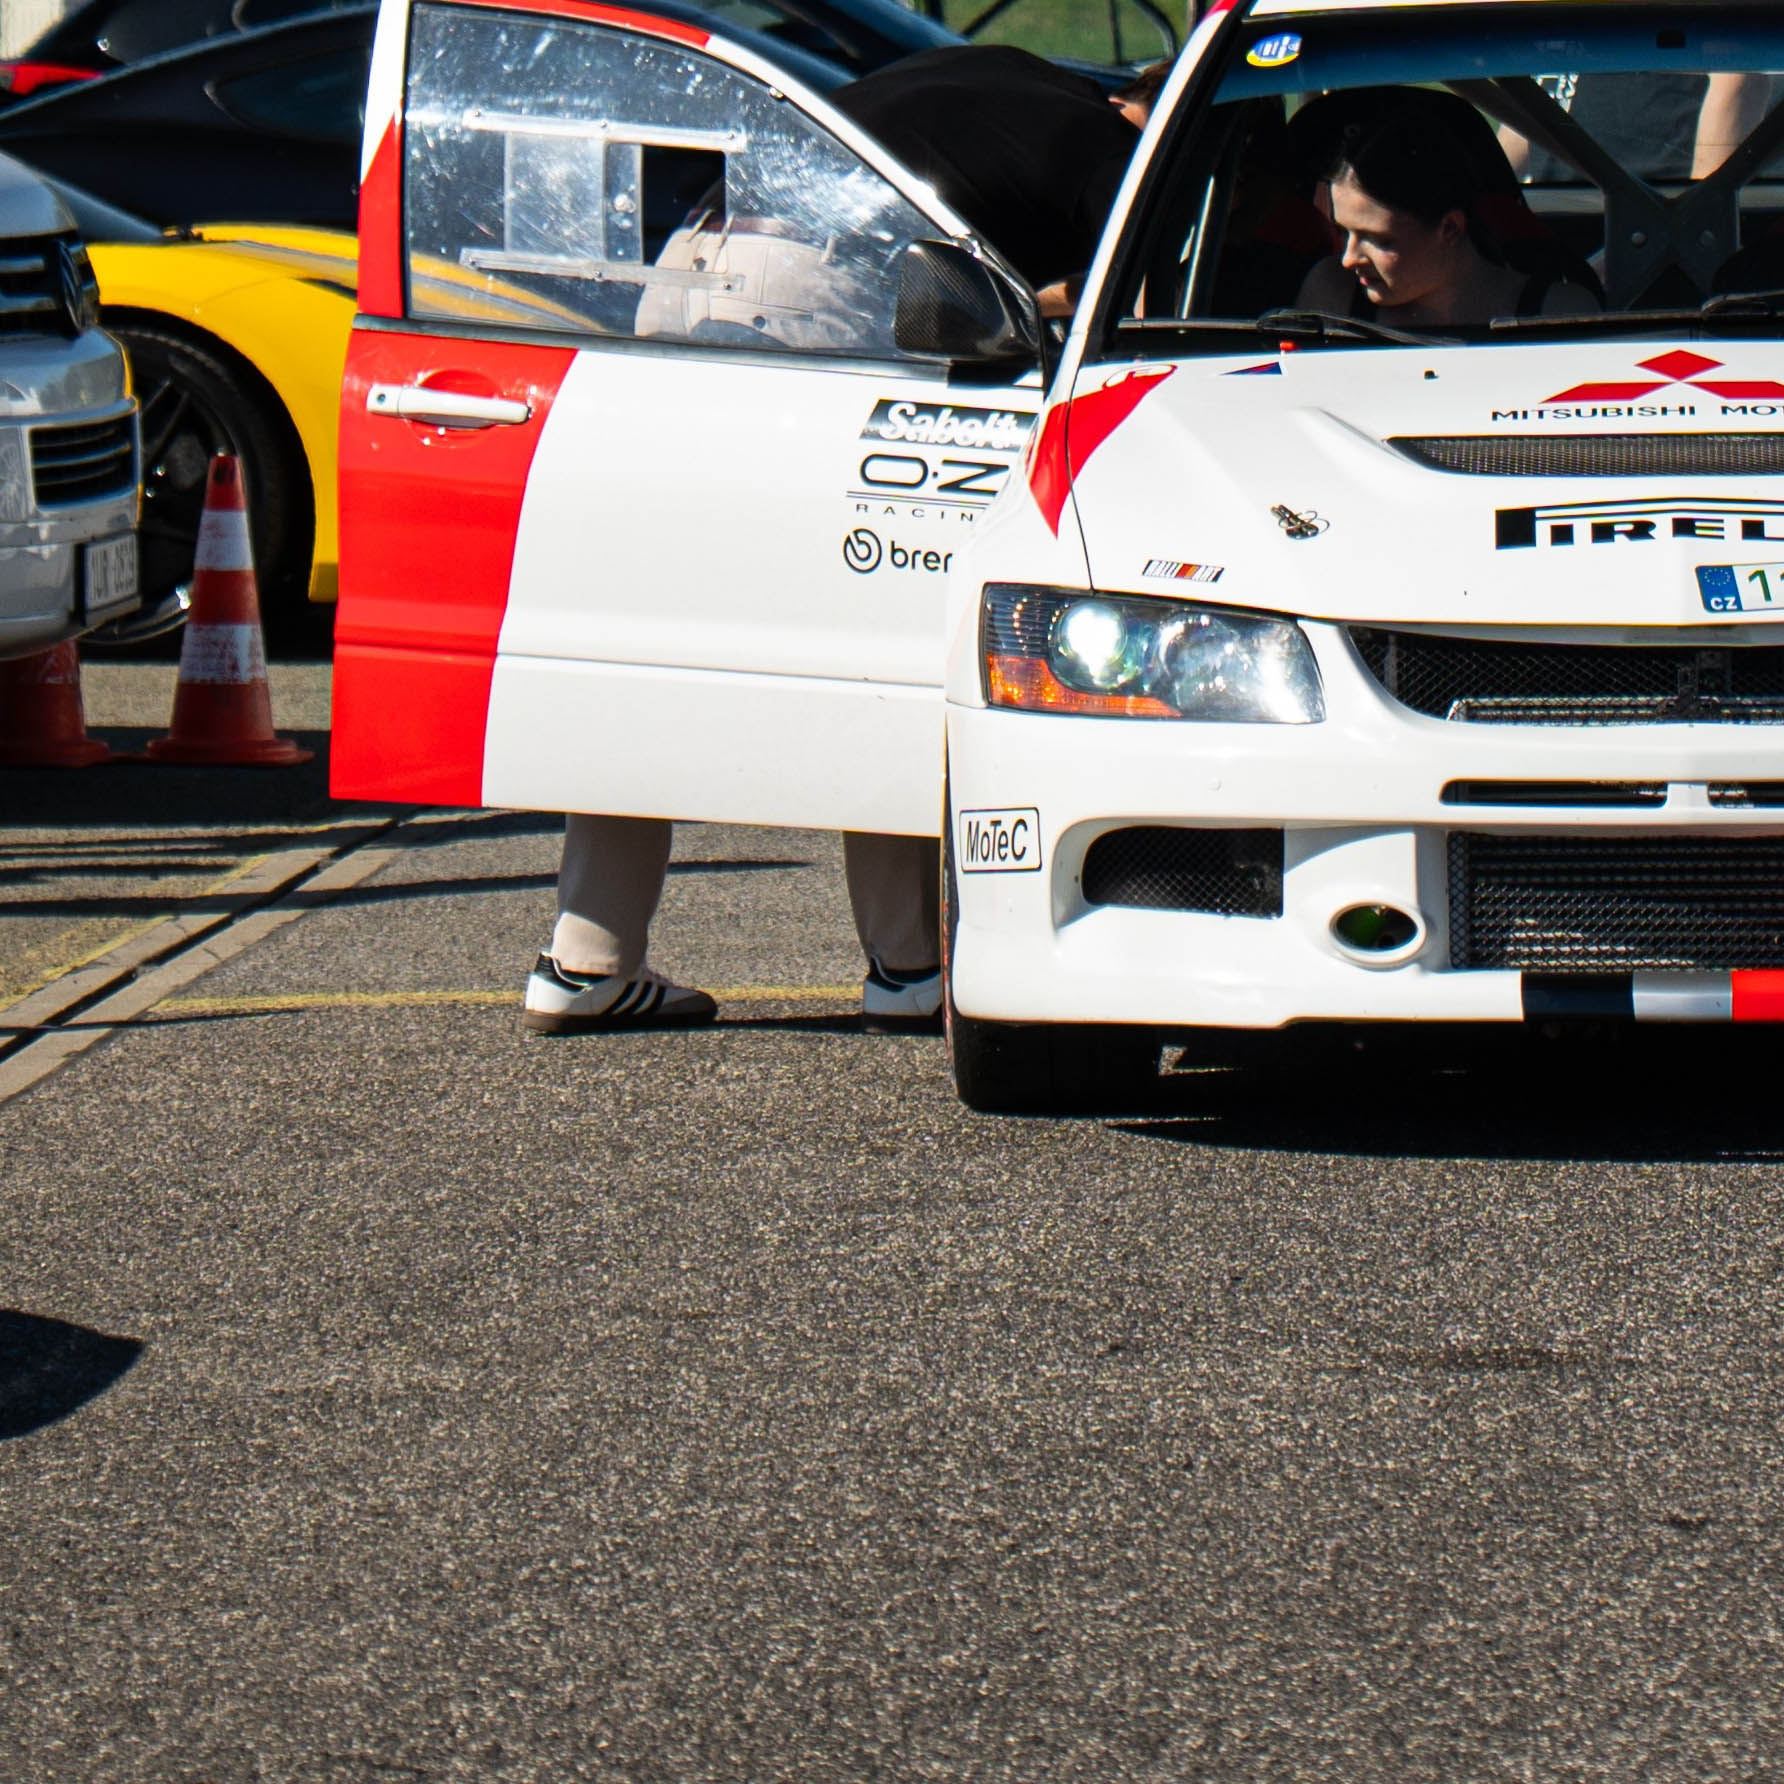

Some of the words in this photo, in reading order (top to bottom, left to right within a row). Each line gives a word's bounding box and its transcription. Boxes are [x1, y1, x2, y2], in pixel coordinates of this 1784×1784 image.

[1492, 405, 1697, 422] MITSUBISHI
[856, 503, 974, 522] RACIN
[1709, 596, 1738, 611] CZ
[966, 818, 1028, 862] MoTeC
